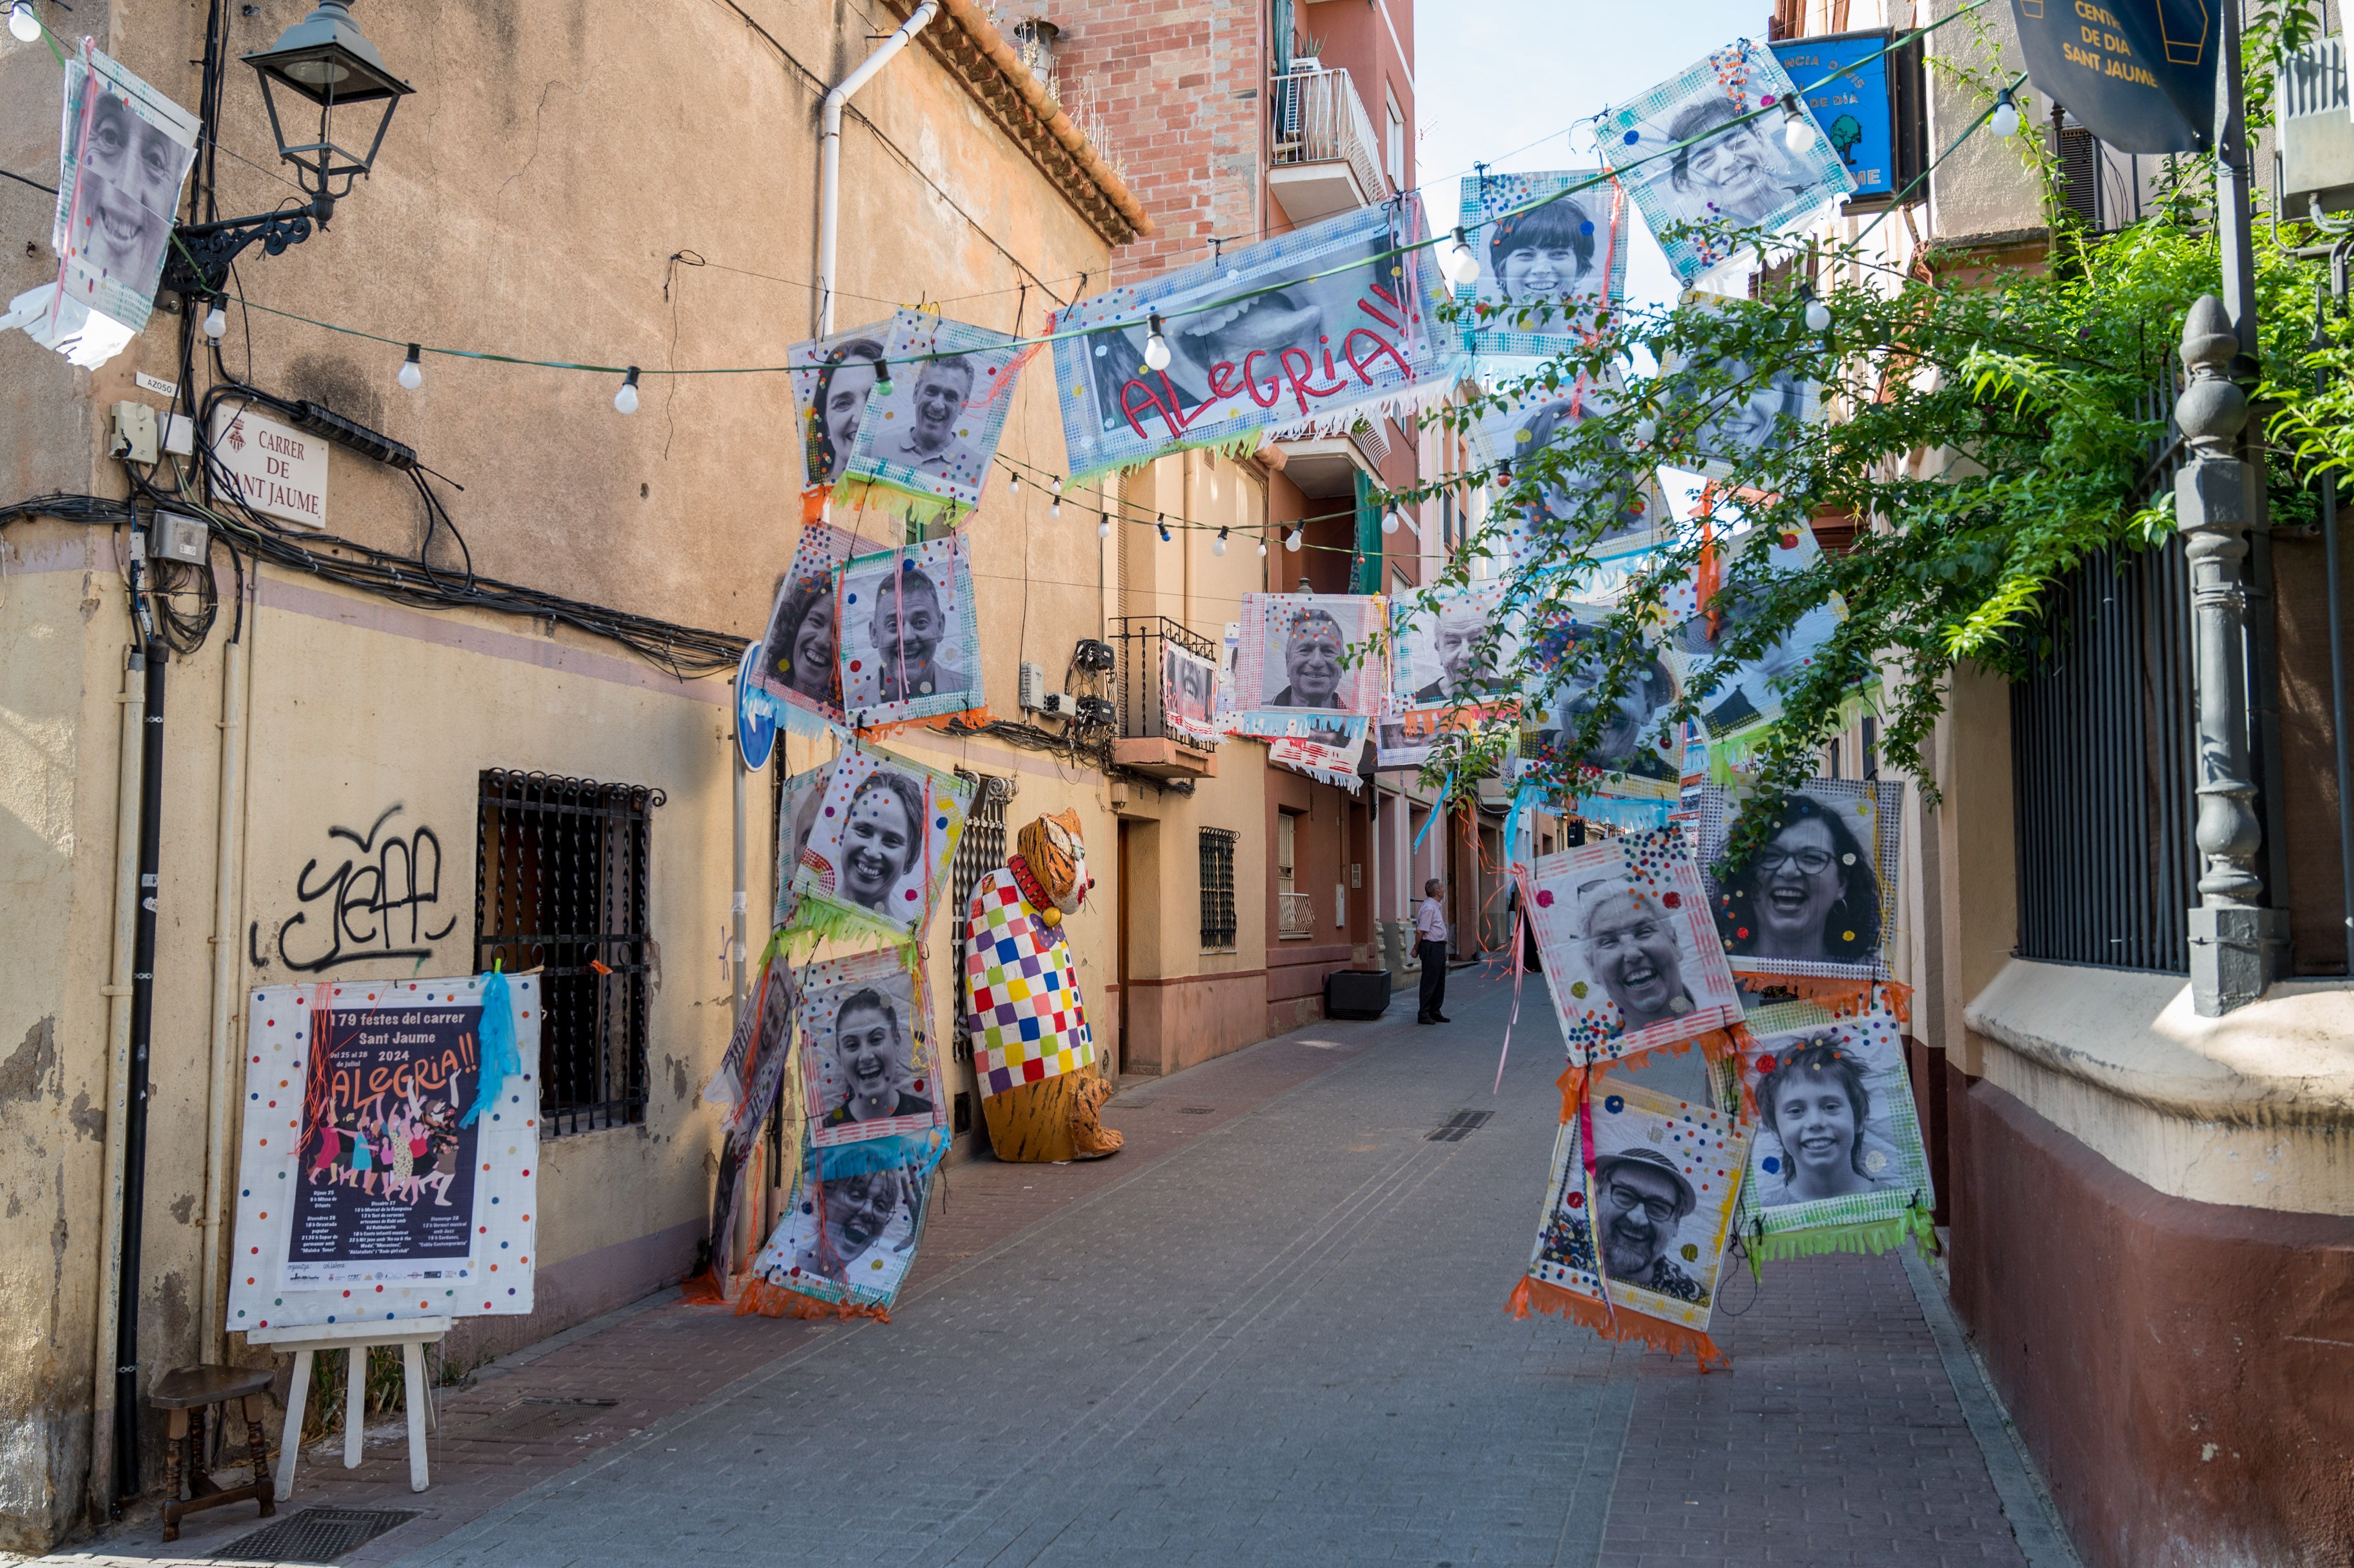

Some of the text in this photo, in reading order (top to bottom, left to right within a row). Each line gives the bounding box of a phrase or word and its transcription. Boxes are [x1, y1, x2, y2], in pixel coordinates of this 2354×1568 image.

[2081, 26, 2131, 56] DE DIA
[2063, 43, 2158, 88] SANT JAUME
[1810, 98, 1829, 109] DE
[259, 430, 305, 461] CARRER
[267, 456, 290, 479] DE
[268, 482, 319, 515] JAUME
[361, 1013, 399, 1026] festes
[402, 1012, 421, 1025] del
[423, 1013, 465, 1024] carrer
[359, 1031, 436, 1045] Sant Jaume
[344, 1060, 361, 1068] juliol
[378, 1050, 410, 1062] 2024
